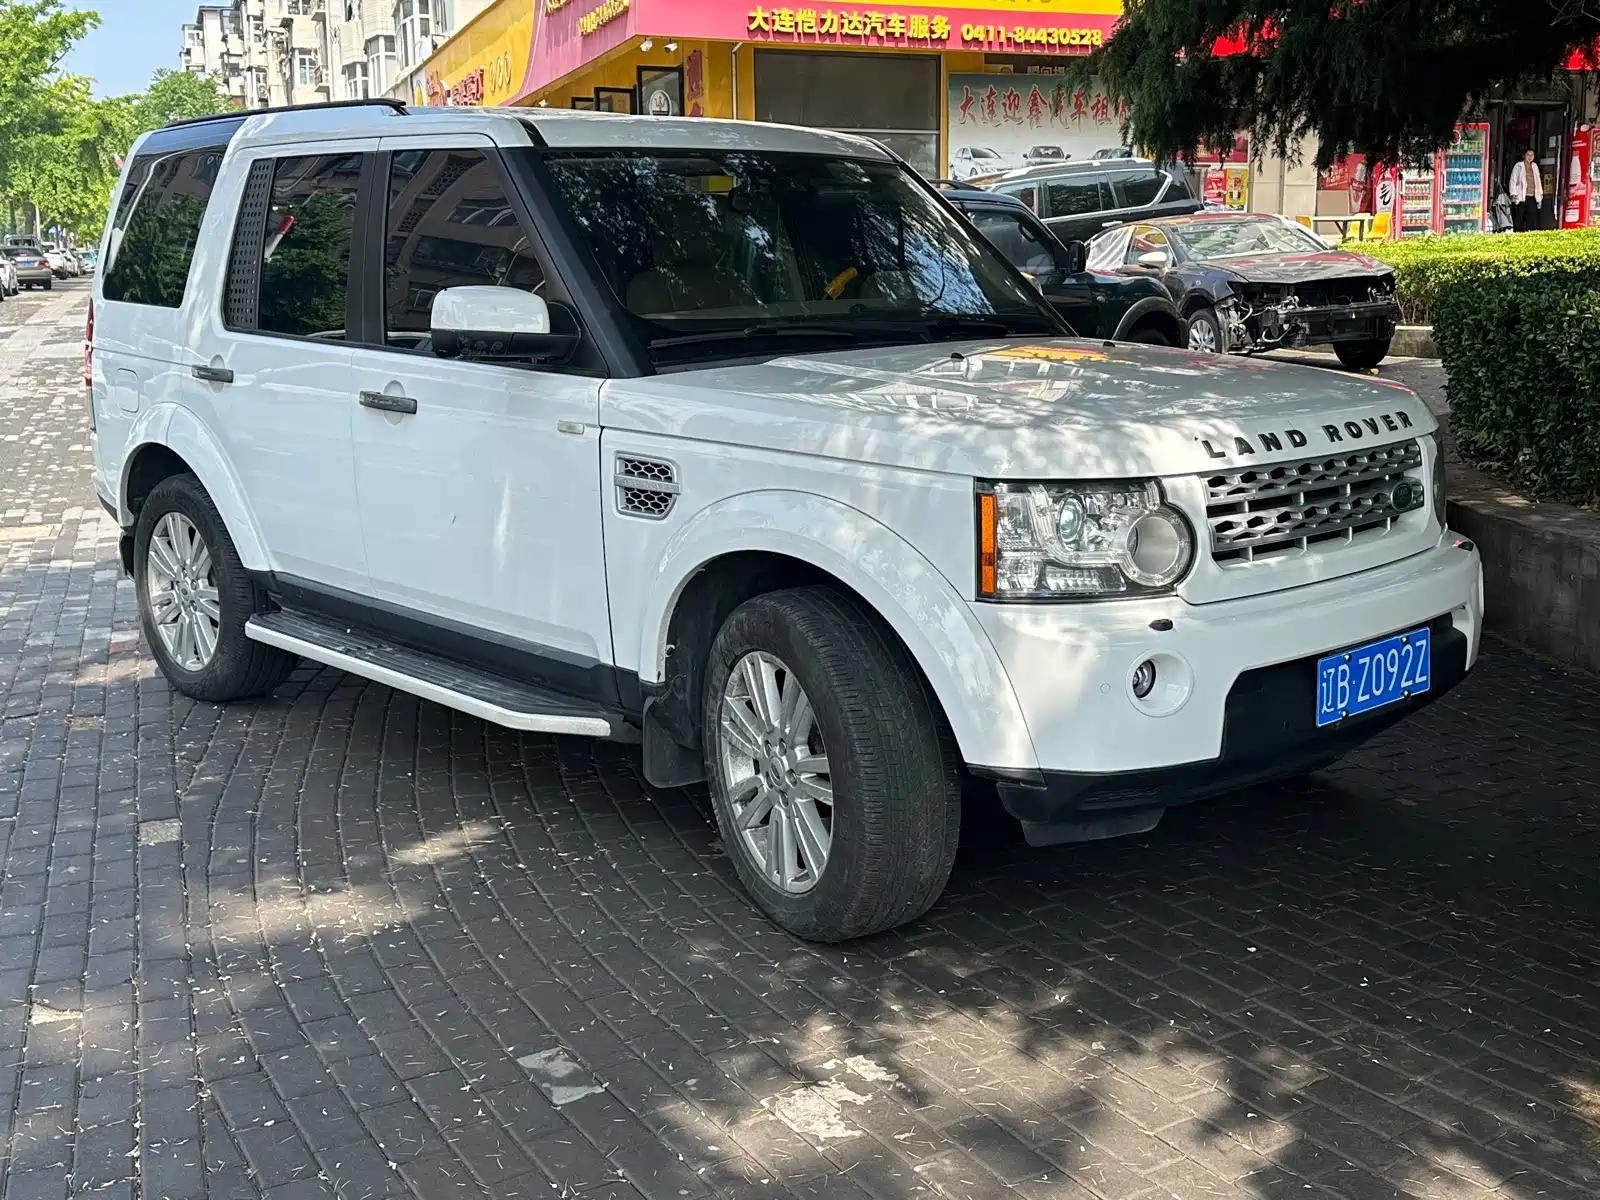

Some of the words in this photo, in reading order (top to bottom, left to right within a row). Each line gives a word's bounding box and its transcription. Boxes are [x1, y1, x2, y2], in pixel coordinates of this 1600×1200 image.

[748, 6, 951, 39] 大连恺力达汽车服务
[961, 23, 1102, 46] 0411-84430528
[1201, 428, 1308, 459] LAND
[1321, 410, 1413, 443] ROVER
